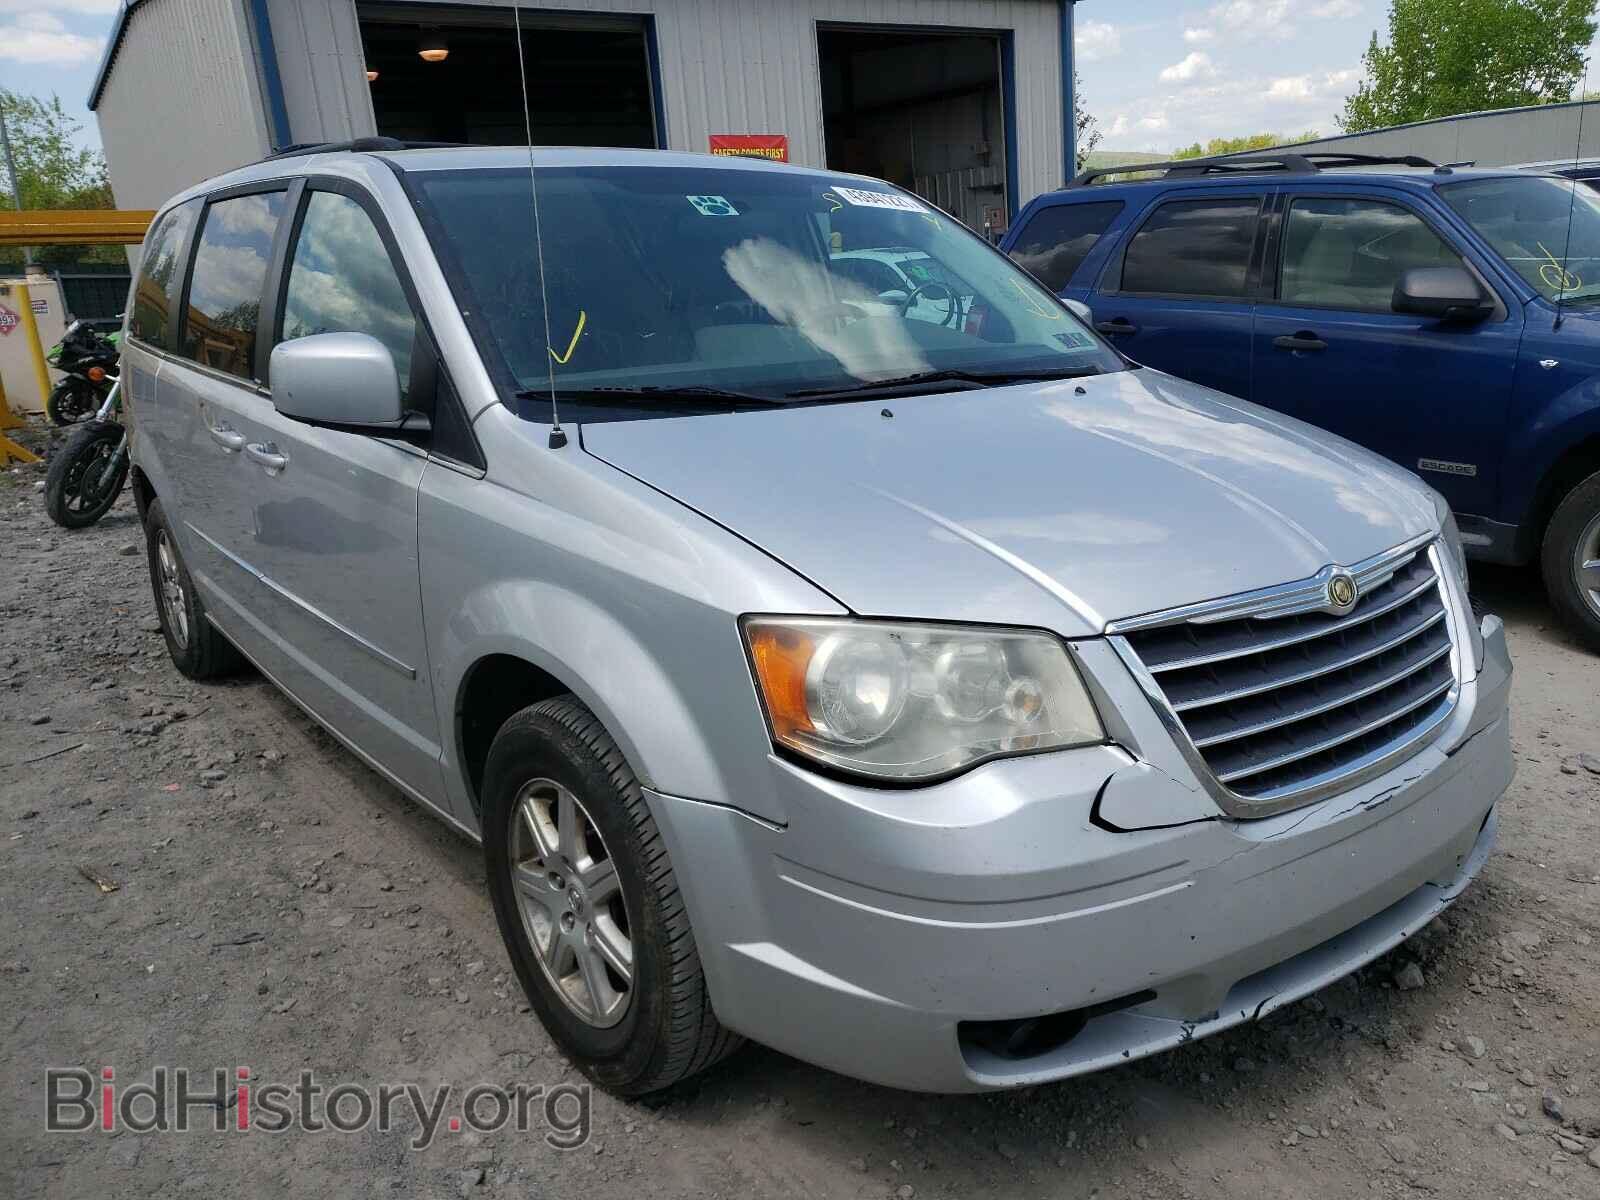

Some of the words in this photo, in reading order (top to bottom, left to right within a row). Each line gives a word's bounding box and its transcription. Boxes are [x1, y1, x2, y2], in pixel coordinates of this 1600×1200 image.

[713, 148, 740, 157] SAFETY
[766, 148, 785, 159] FIRST
[1423, 461, 1474, 474] ESCAPE
